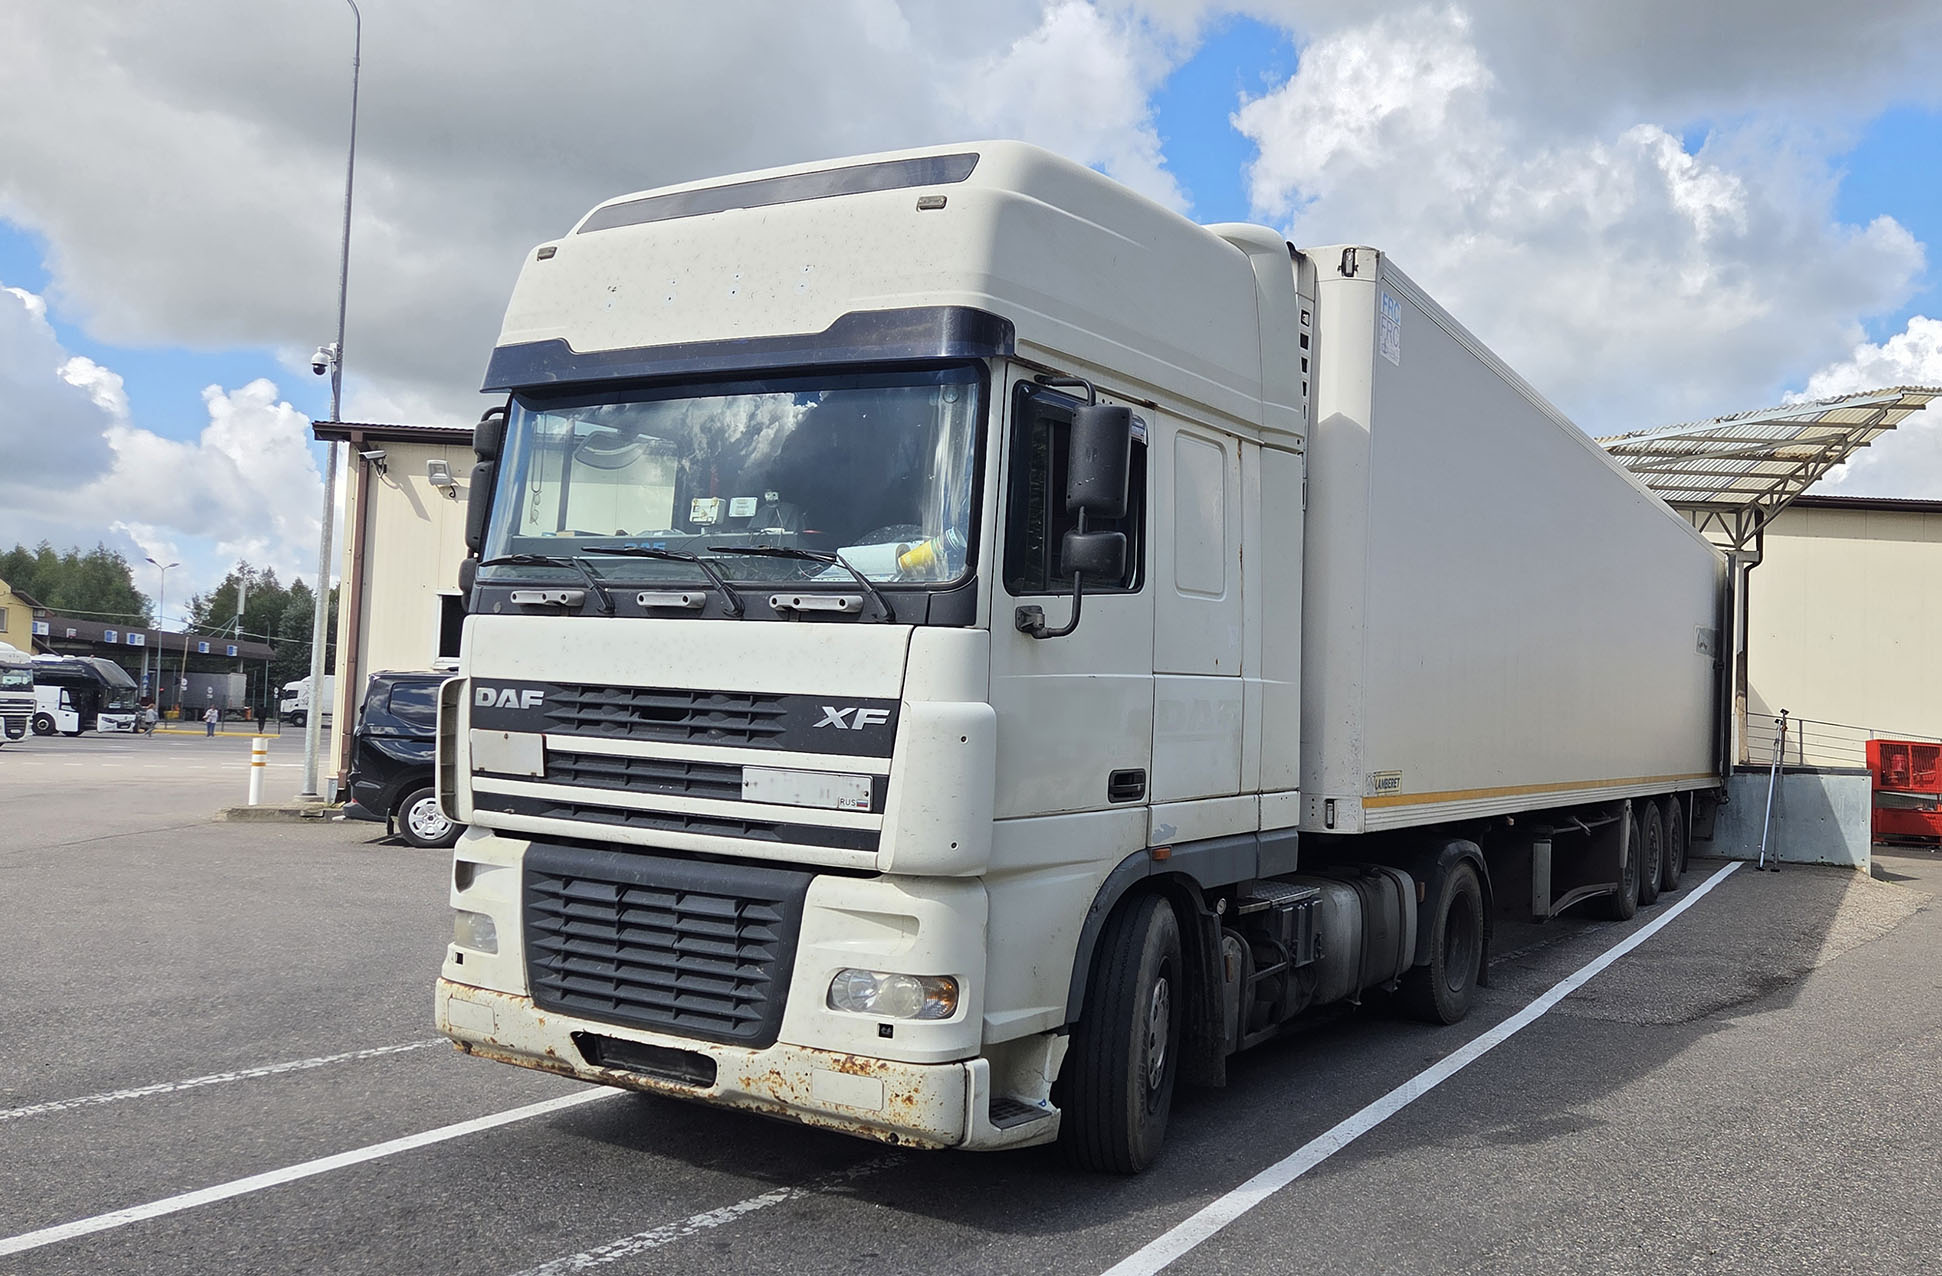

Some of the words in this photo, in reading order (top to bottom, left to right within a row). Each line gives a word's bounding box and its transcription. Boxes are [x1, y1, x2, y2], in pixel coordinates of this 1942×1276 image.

[475, 687, 544, 709] DAF
[812, 706, 890, 729] XF
[840, 798, 856, 806] RUS
